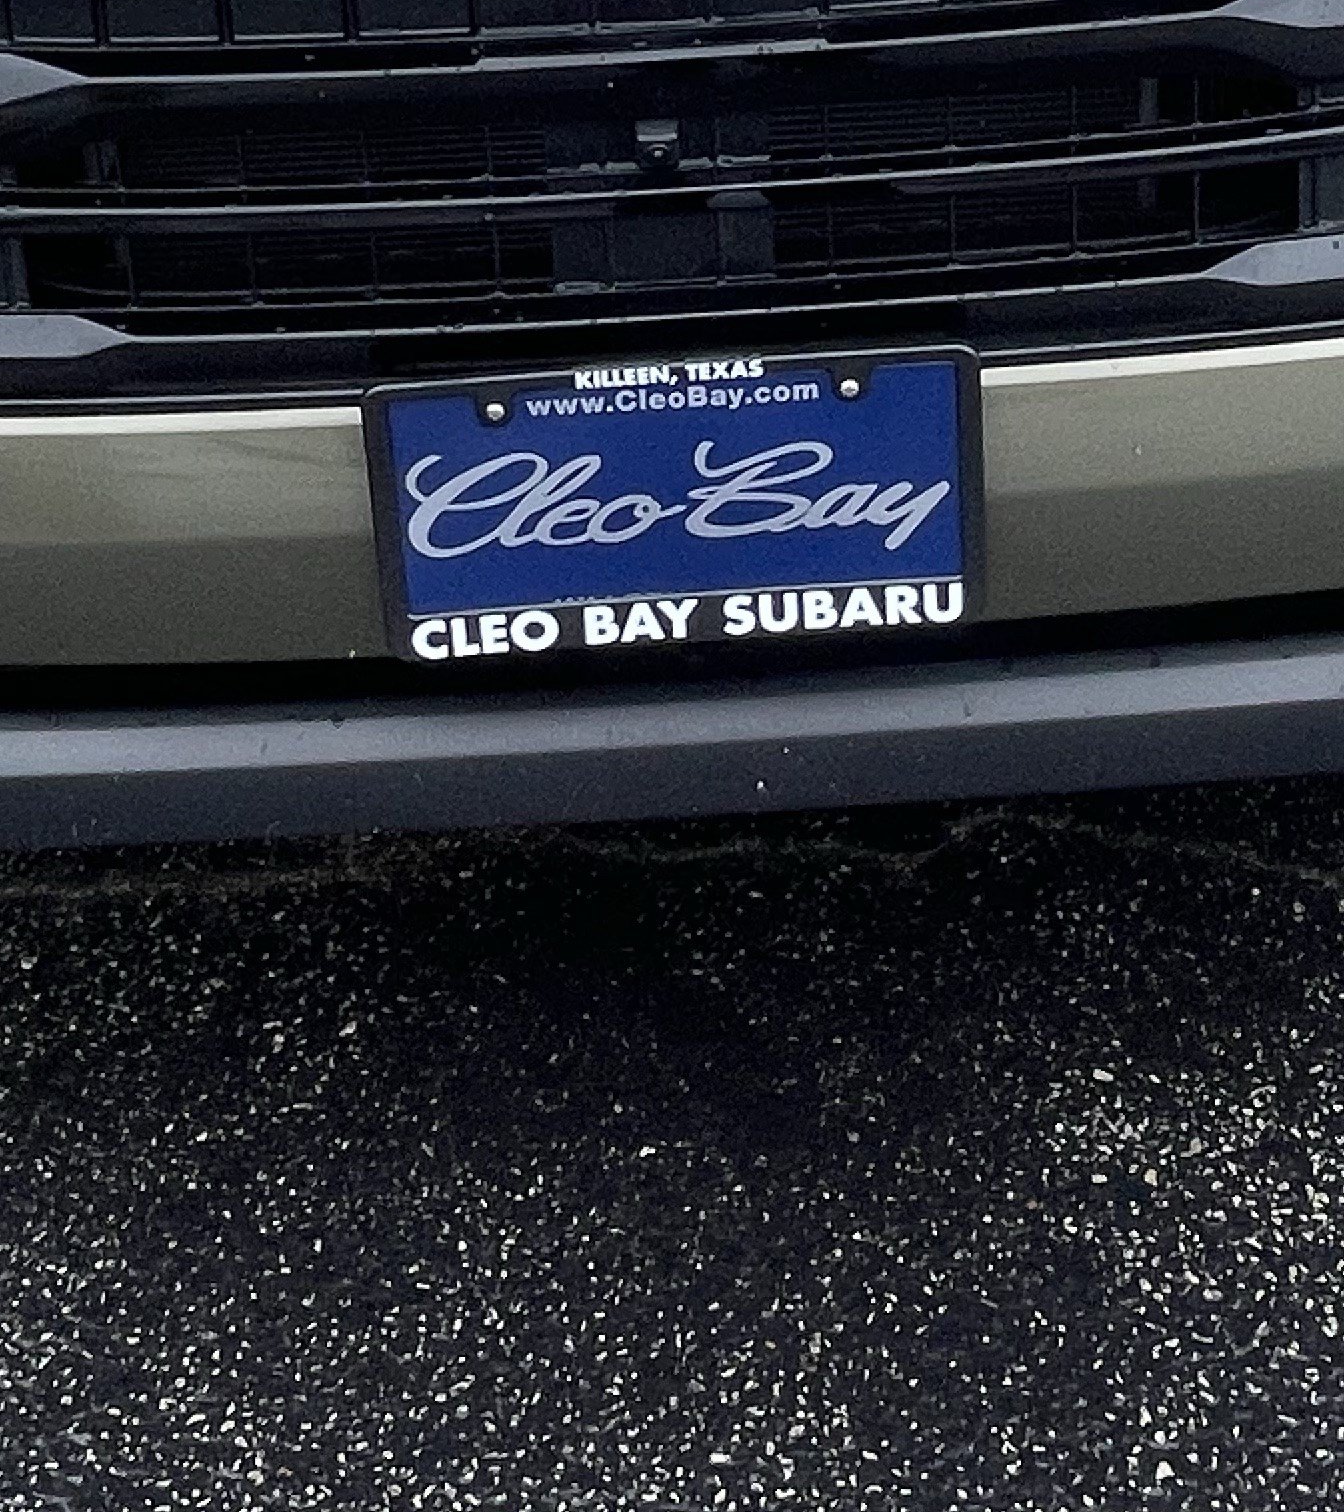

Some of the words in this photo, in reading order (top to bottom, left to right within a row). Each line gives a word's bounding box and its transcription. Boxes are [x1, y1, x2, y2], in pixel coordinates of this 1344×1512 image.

[526, 382, 821, 416] www.CleoBay.com
[574, 364, 678, 389] KILLEEN,
[684, 359, 764, 381] TEXAS
[405, 452, 687, 558] Cleo
[685, 440, 950, 550] Bay
[411, 609, 560, 660] CLEO
[582, 598, 699, 646] BAY
[722, 582, 964, 637] SUBARU
